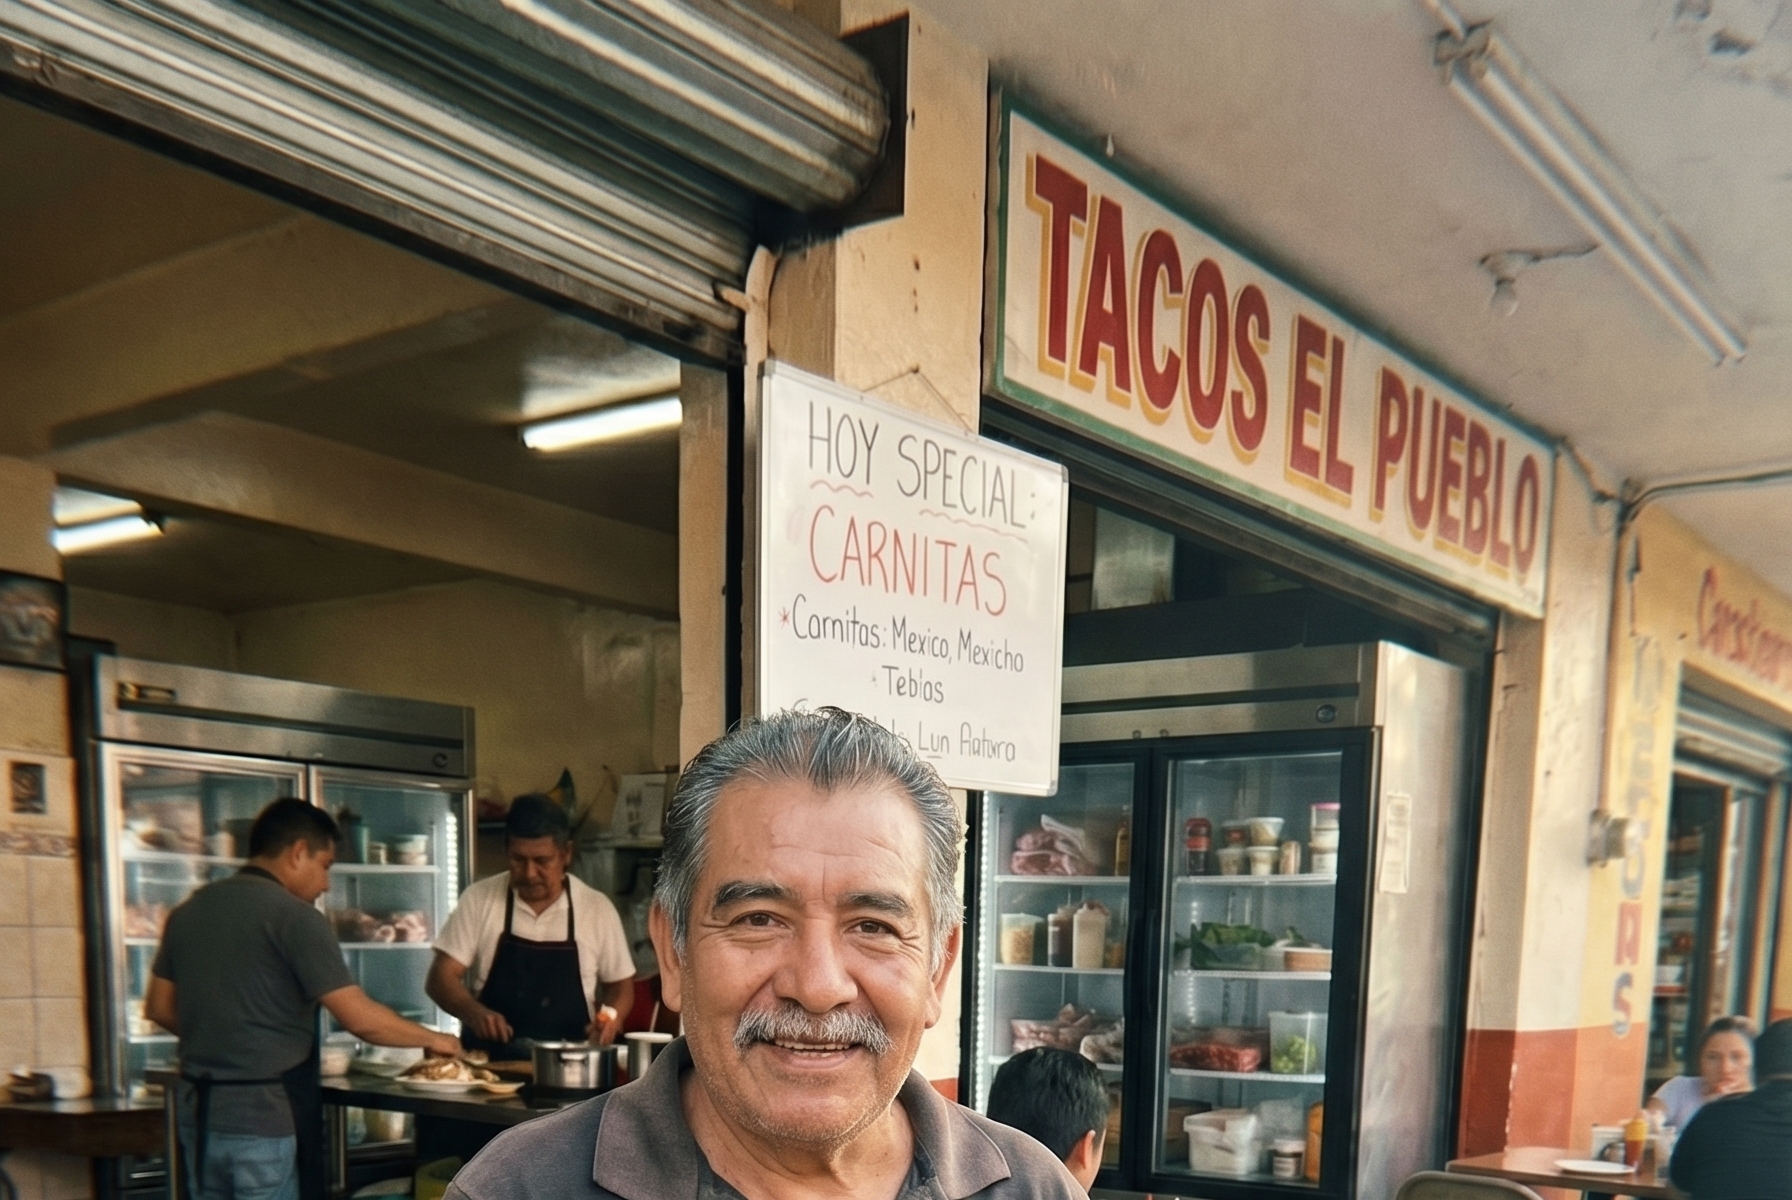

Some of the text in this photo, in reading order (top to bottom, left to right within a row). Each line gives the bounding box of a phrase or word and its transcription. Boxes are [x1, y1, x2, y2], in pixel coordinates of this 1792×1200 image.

[1026, 152, 1540, 577] TACOS EL PUEBLO
[808, 400, 880, 485] HOY
[809, 504, 1008, 617] CARNITAS
[957, 626, 1024, 673] Mexicho
[918, 720, 950, 755] Lun
